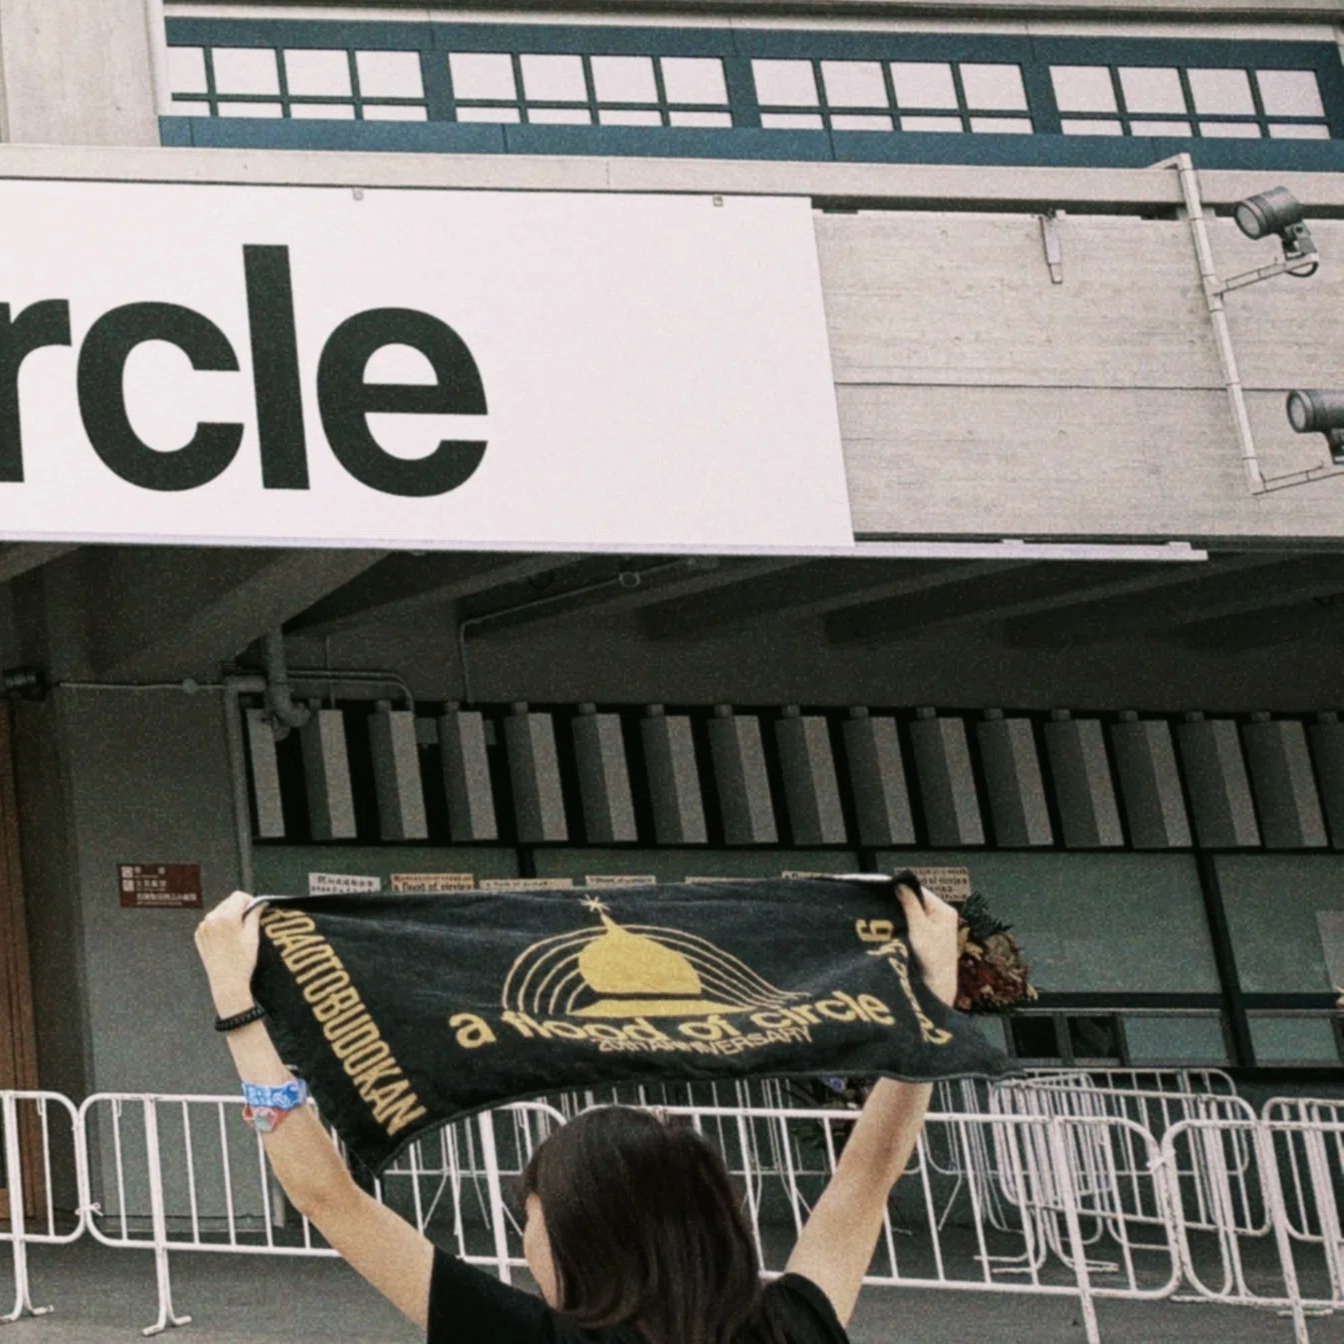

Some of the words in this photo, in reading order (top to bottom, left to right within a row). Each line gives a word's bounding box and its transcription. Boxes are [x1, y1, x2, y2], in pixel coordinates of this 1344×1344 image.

[449, 1013, 498, 1049] a
[500, 1009, 669, 1042] flood
[678, 1014, 744, 1041] of
[750, 990, 896, 1029] circle
